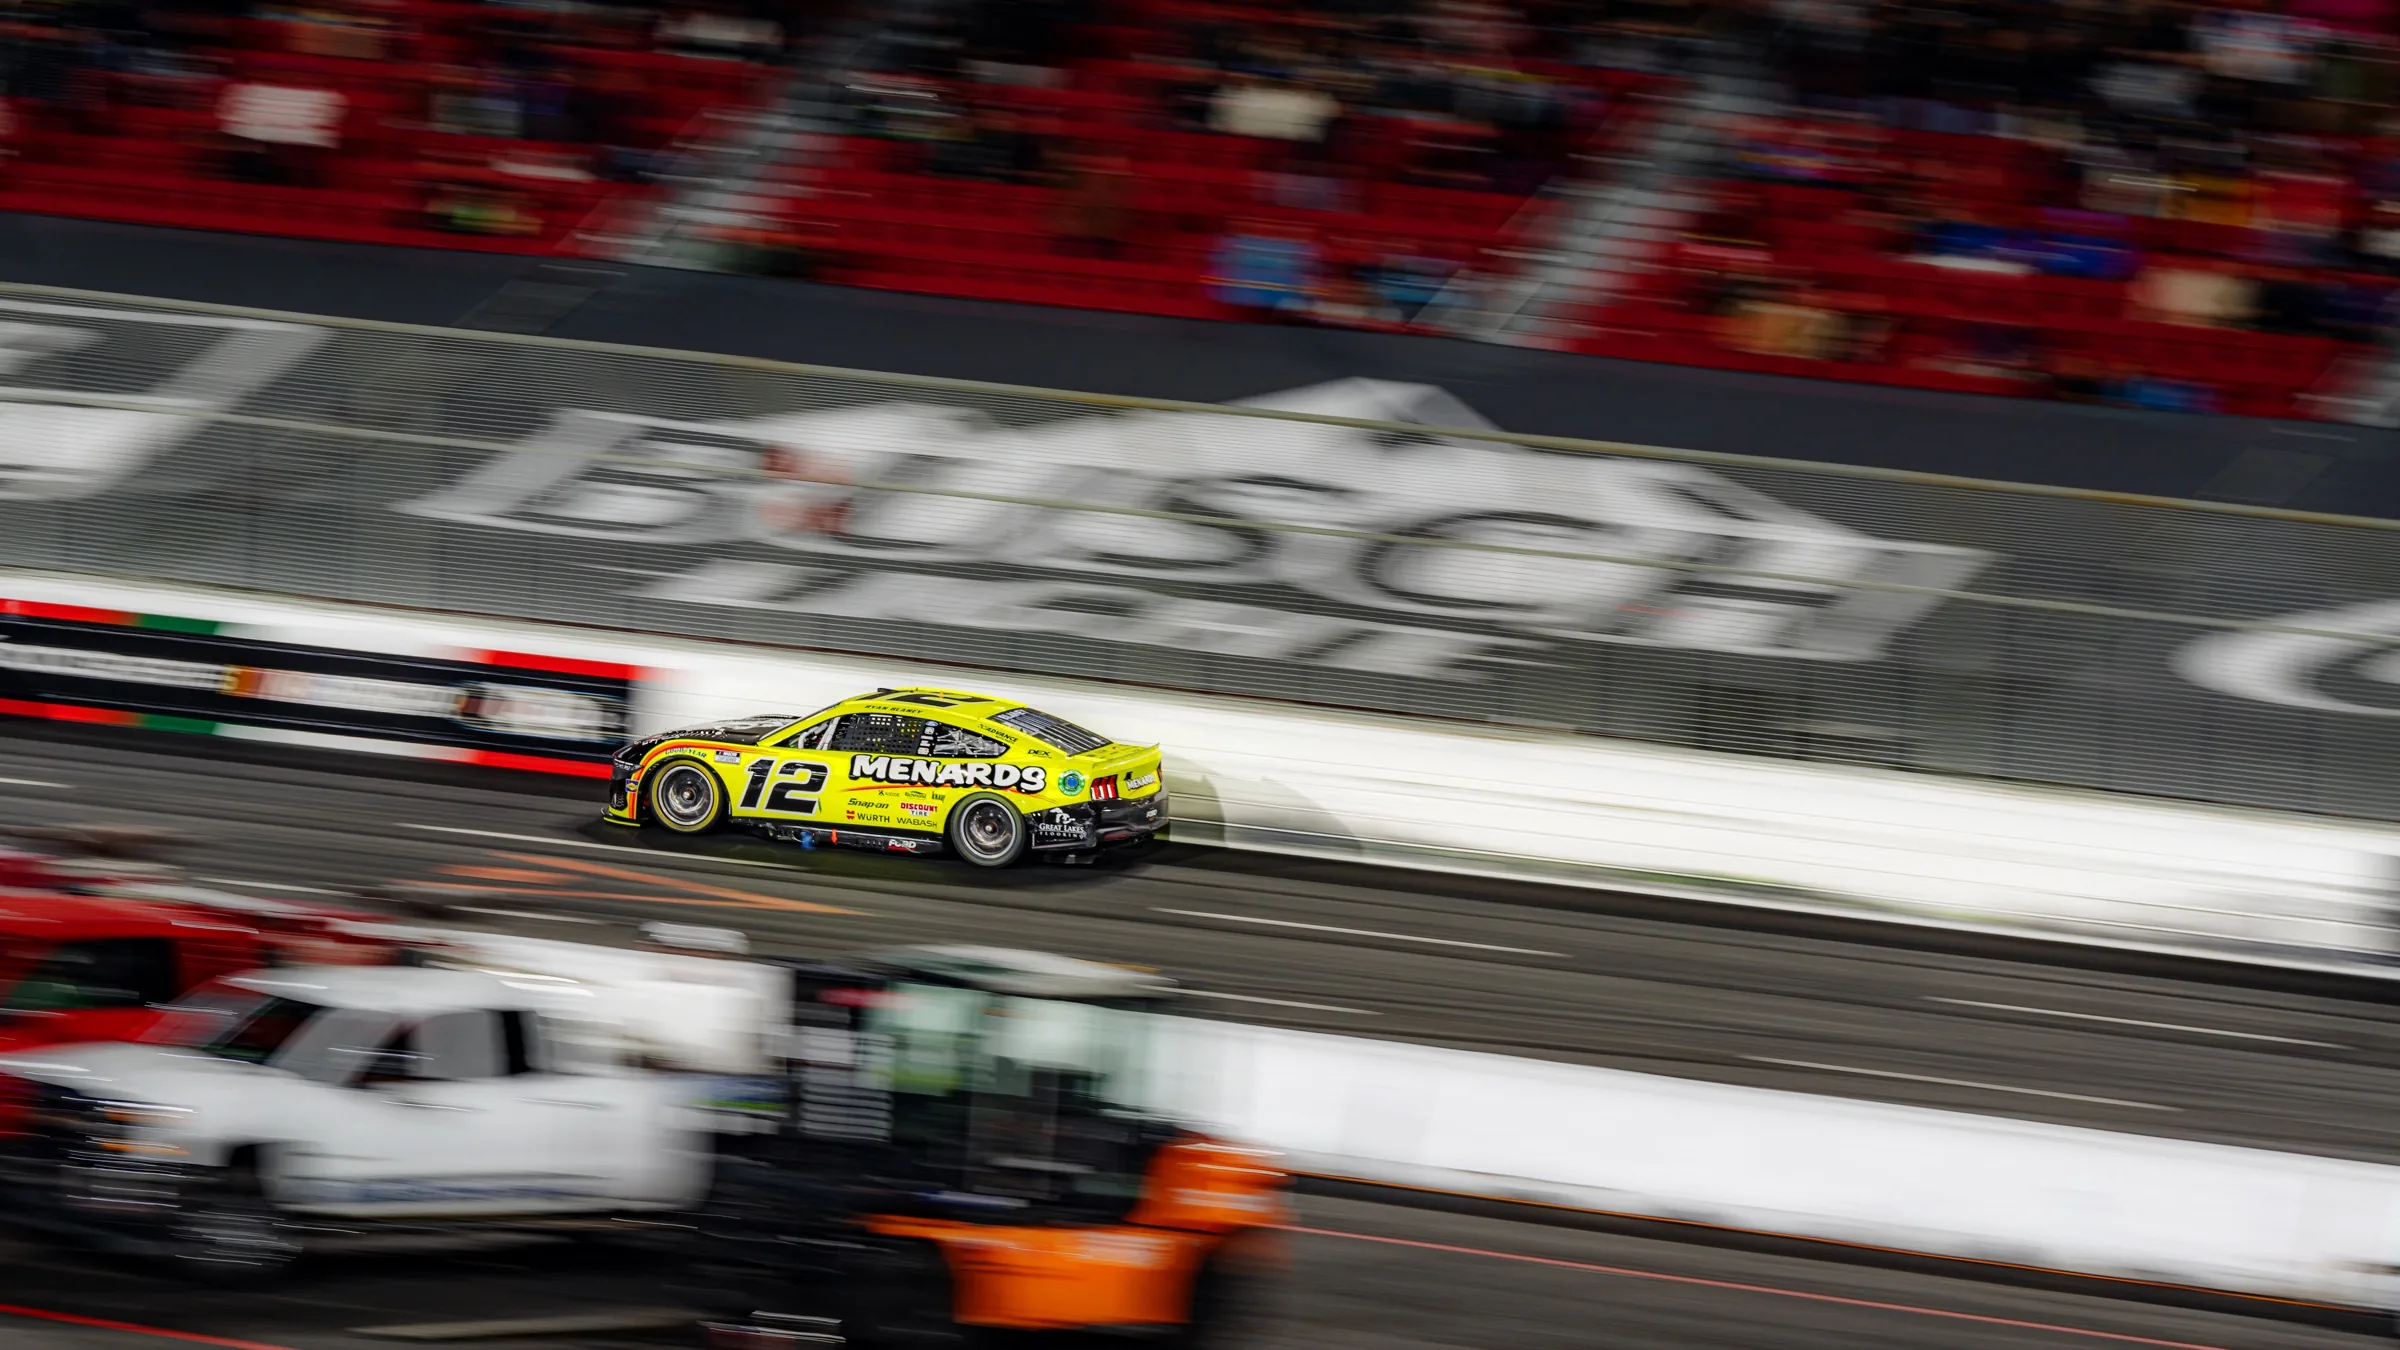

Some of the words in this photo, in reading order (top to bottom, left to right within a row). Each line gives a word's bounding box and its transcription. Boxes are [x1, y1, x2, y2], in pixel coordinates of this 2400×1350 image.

[849, 754, 1047, 794] MENARDS
[737, 756, 830, 816] 12
[900, 802, 938, 812] DISCOUNT
[857, 812, 890, 822] WÜRTH
[896, 817, 938, 828] WABASH
[1039, 823, 1062, 832] GREAT
[1063, 823, 1085, 833] LAKES
[888, 839, 917, 849] FORD
